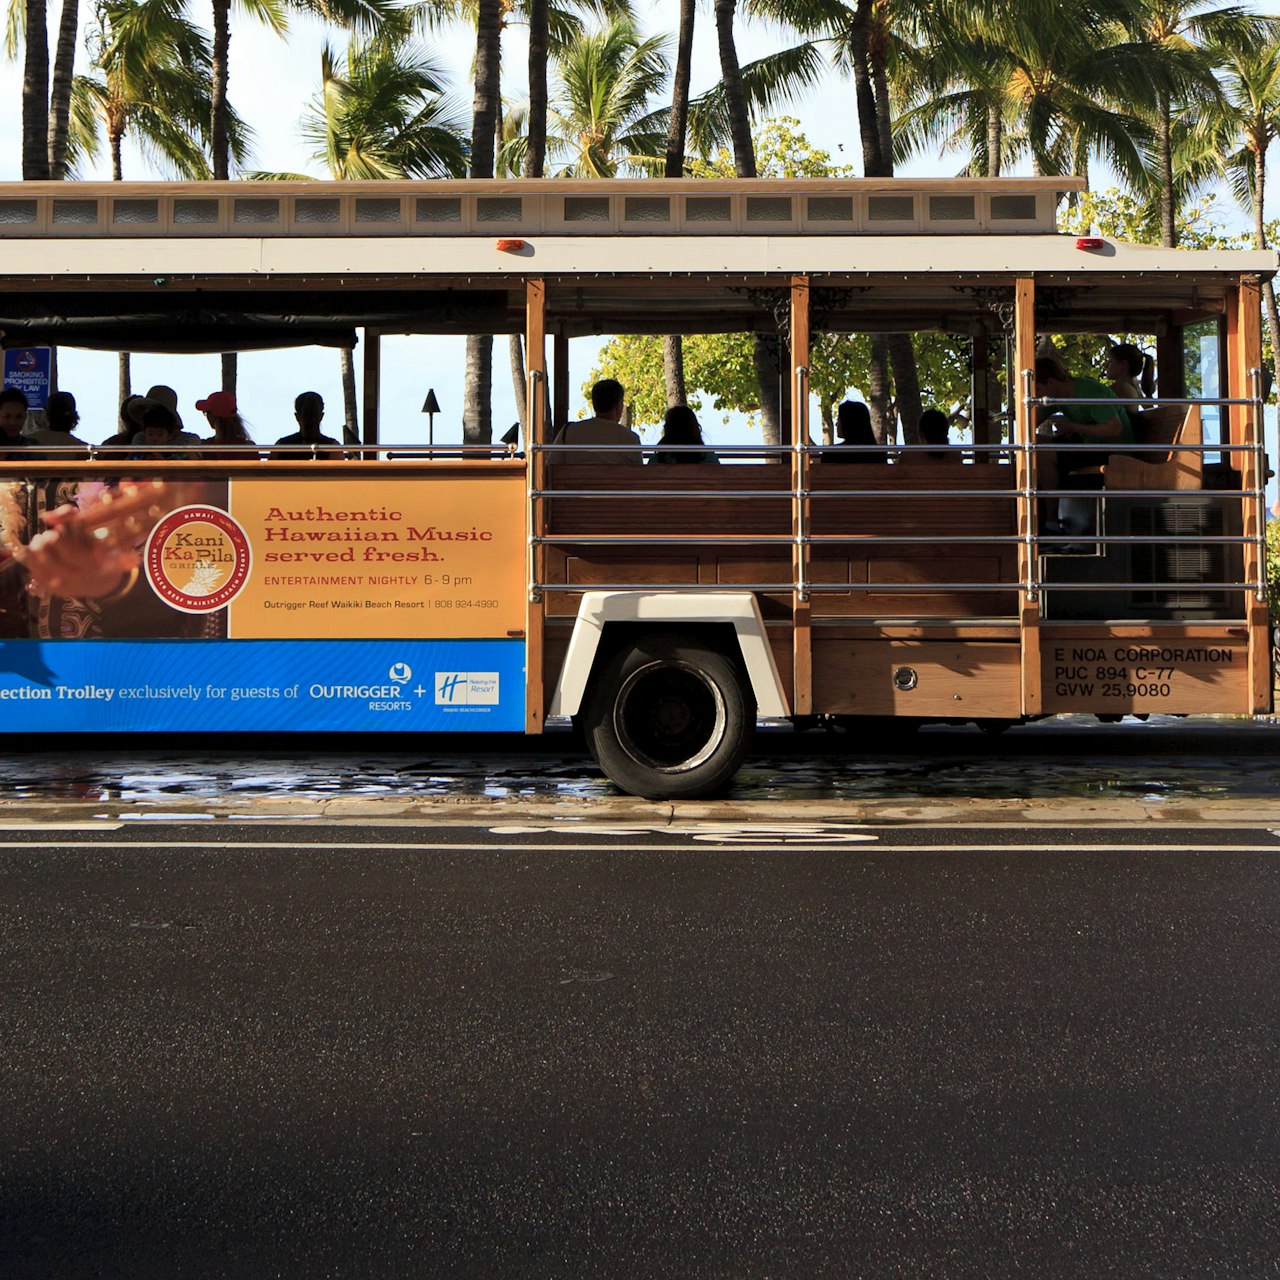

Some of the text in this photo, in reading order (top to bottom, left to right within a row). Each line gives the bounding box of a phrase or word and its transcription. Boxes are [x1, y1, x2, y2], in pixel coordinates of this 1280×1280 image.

[264, 506, 402, 521] Authentic
[175, 533, 224, 546] Kani
[264, 526, 493, 542] Hawaiian Music
[164, 547, 234, 563] Ka Pila
[264, 546, 445, 562] served fresh.
[152, 548, 246, 606] OUTRIGGER REEF WAIKIKI BEACH RESORT
[264, 576, 364, 585] ENTERTAINMENT
[368, 576, 418, 585] NIGHTLY
[454, 577, 472, 587] pm
[264, 600, 499, 610] Outrigger Reef Waikiki Beach Resort 808 924-4990
[1055, 649, 1232, 662] E NOA CORPORATION
[1055, 667, 1175, 680] PUC 894 C-77
[55, 685, 115, 701] Trolley
[118, 685, 202, 701] exclusively
[206, 685, 227, 698] for
[231, 686, 280, 701] guests
[283, 685, 299, 698] of
[309, 684, 401, 699] OUTRIGGER
[471, 685, 494, 693] Resort
[1056, 683, 1170, 699] GVW 25,9080
[369, 701, 412, 711] RESORTS
